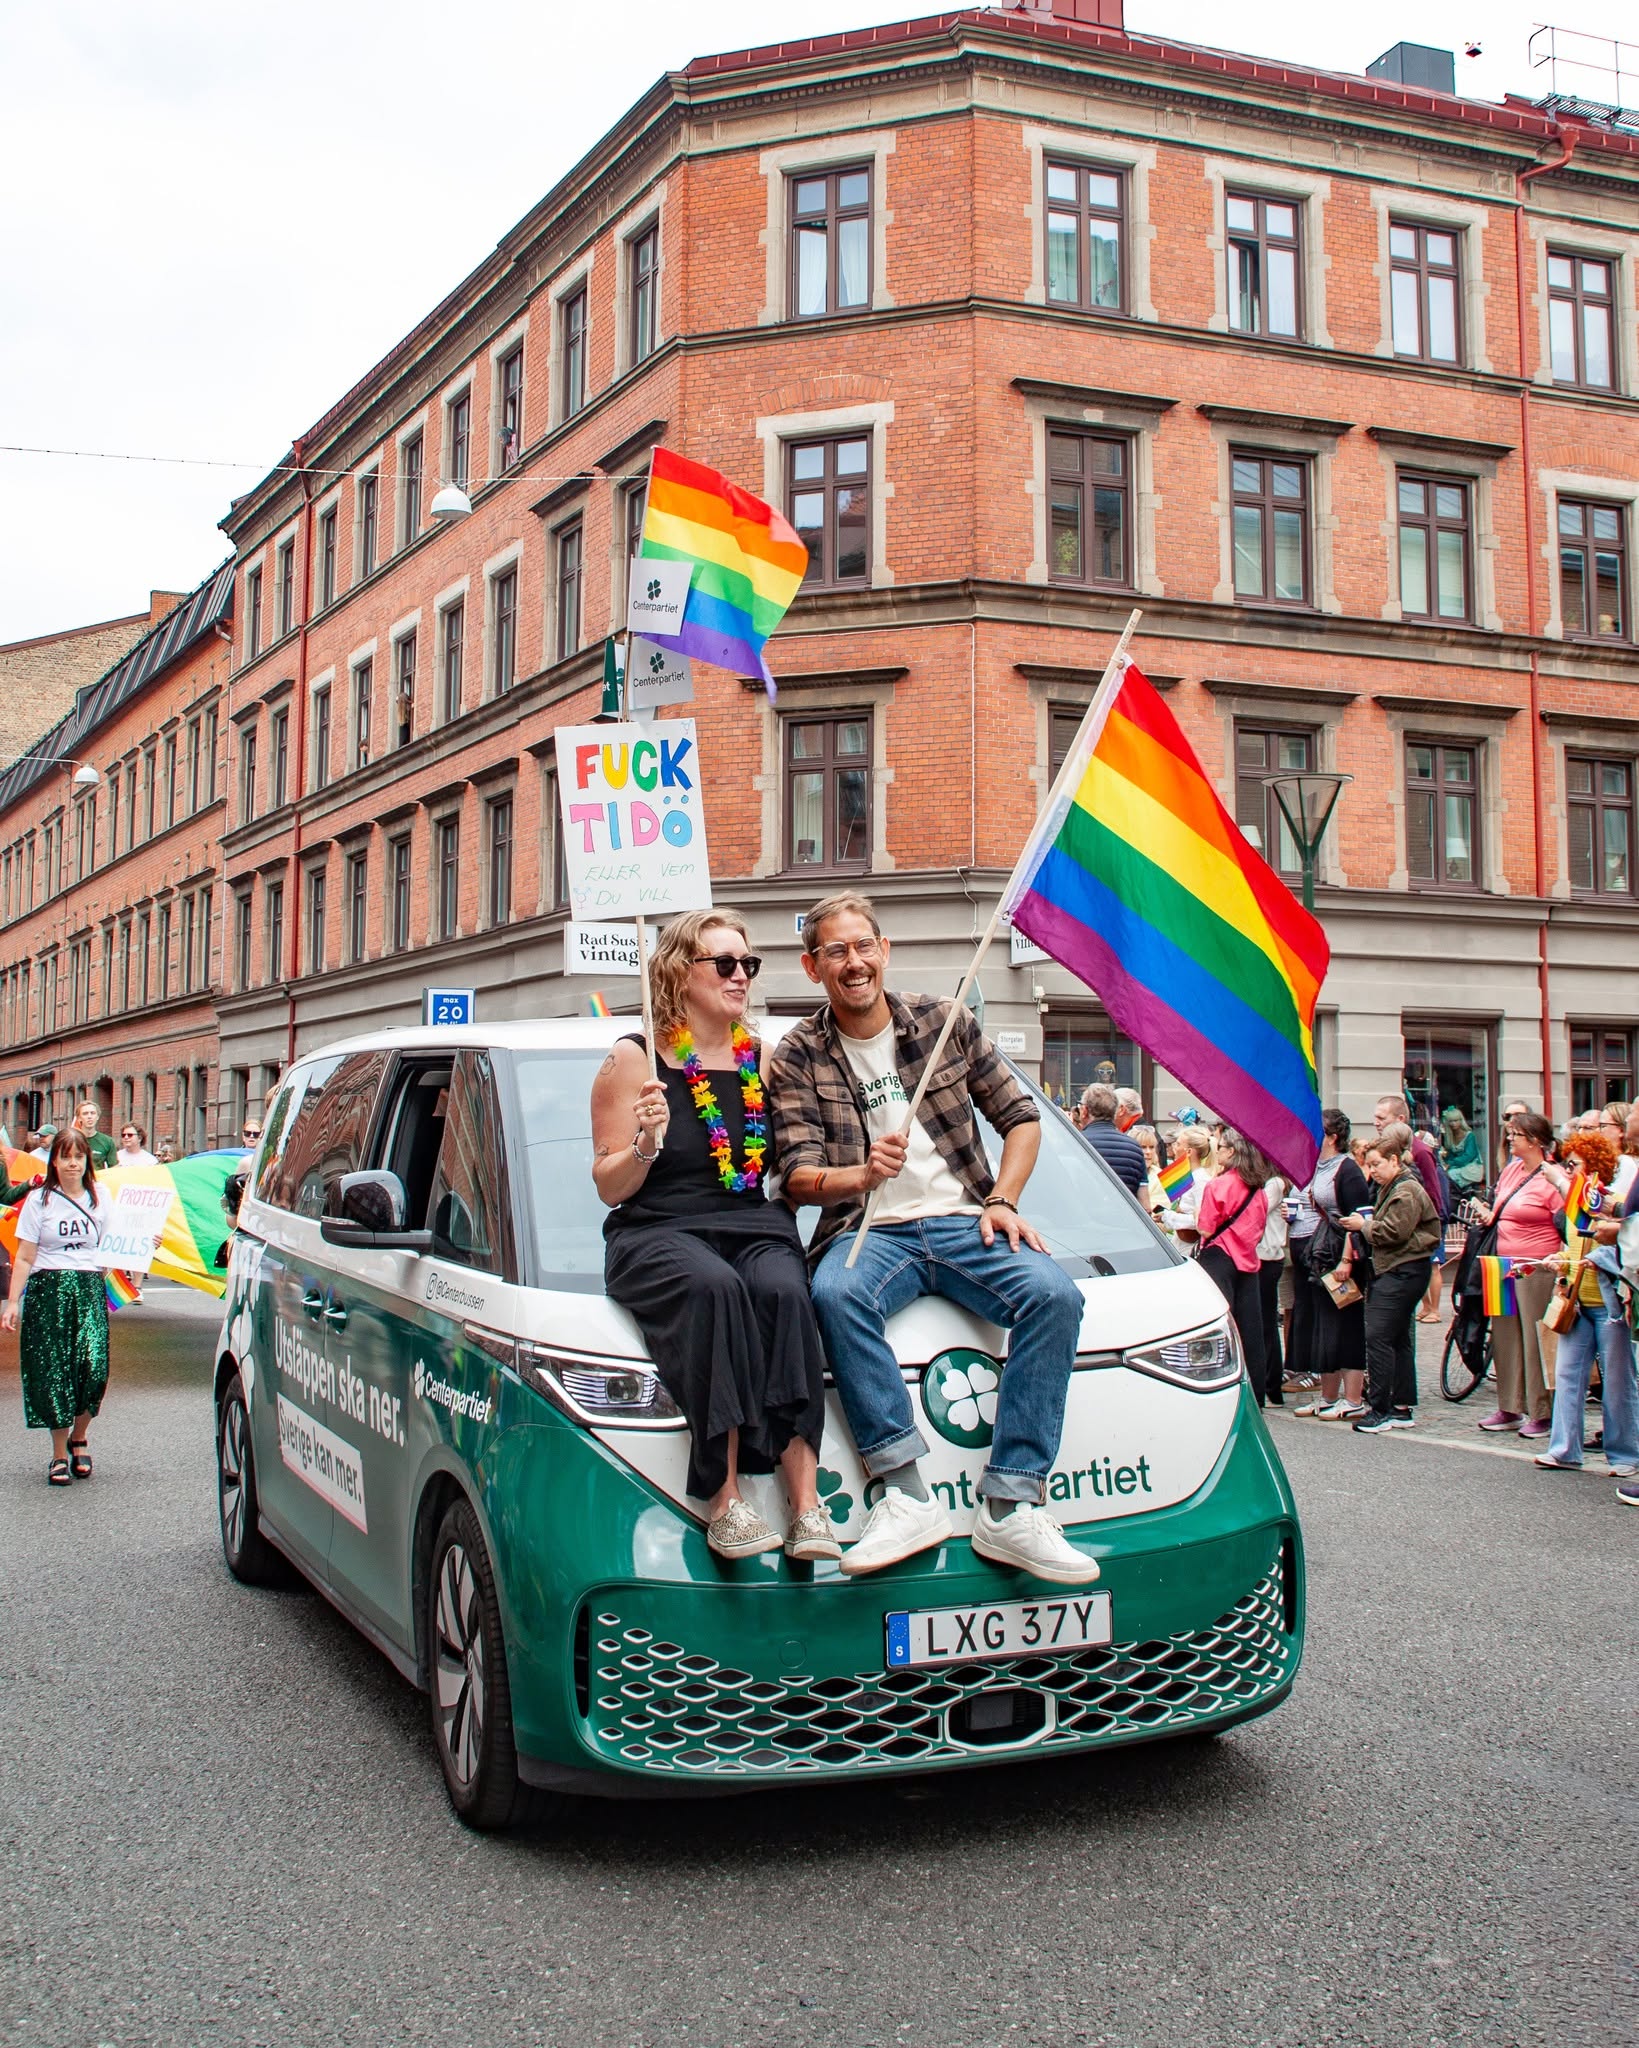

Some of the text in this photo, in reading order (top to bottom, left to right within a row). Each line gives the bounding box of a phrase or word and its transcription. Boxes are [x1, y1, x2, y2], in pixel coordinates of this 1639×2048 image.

[632, 600, 679, 614] Centerpartiet
[633, 671, 685, 687] Centerpartiet
[576, 738, 693, 792] FUCK
[569, 795, 693, 854] TIDÖ
[585, 862, 695, 881] ELLER VEM
[596, 888, 673, 906] DU VILL
[580, 933, 608, 946] Rad
[580, 946, 640, 967] vintag
[438, 1006, 463, 1019] 20
[858, 1072, 902, 1096] Sverig
[891, 1090, 908, 1102] me
[120, 1188, 171, 1209] PROTECT
[59, 1219, 89, 1236] GAY
[101, 1234, 149, 1257] DOLLS
[436, 1280, 485, 1311] @Centerbussen
[275, 1316, 404, 1447] Utsläppen ska ner.
[425, 1371, 491, 1424] Centerpartiet
[280, 1401, 362, 1505] Sverige kan mer.
[927, 1600, 1094, 1656] LXG 37Y
[895, 1646, 904, 1657] S
